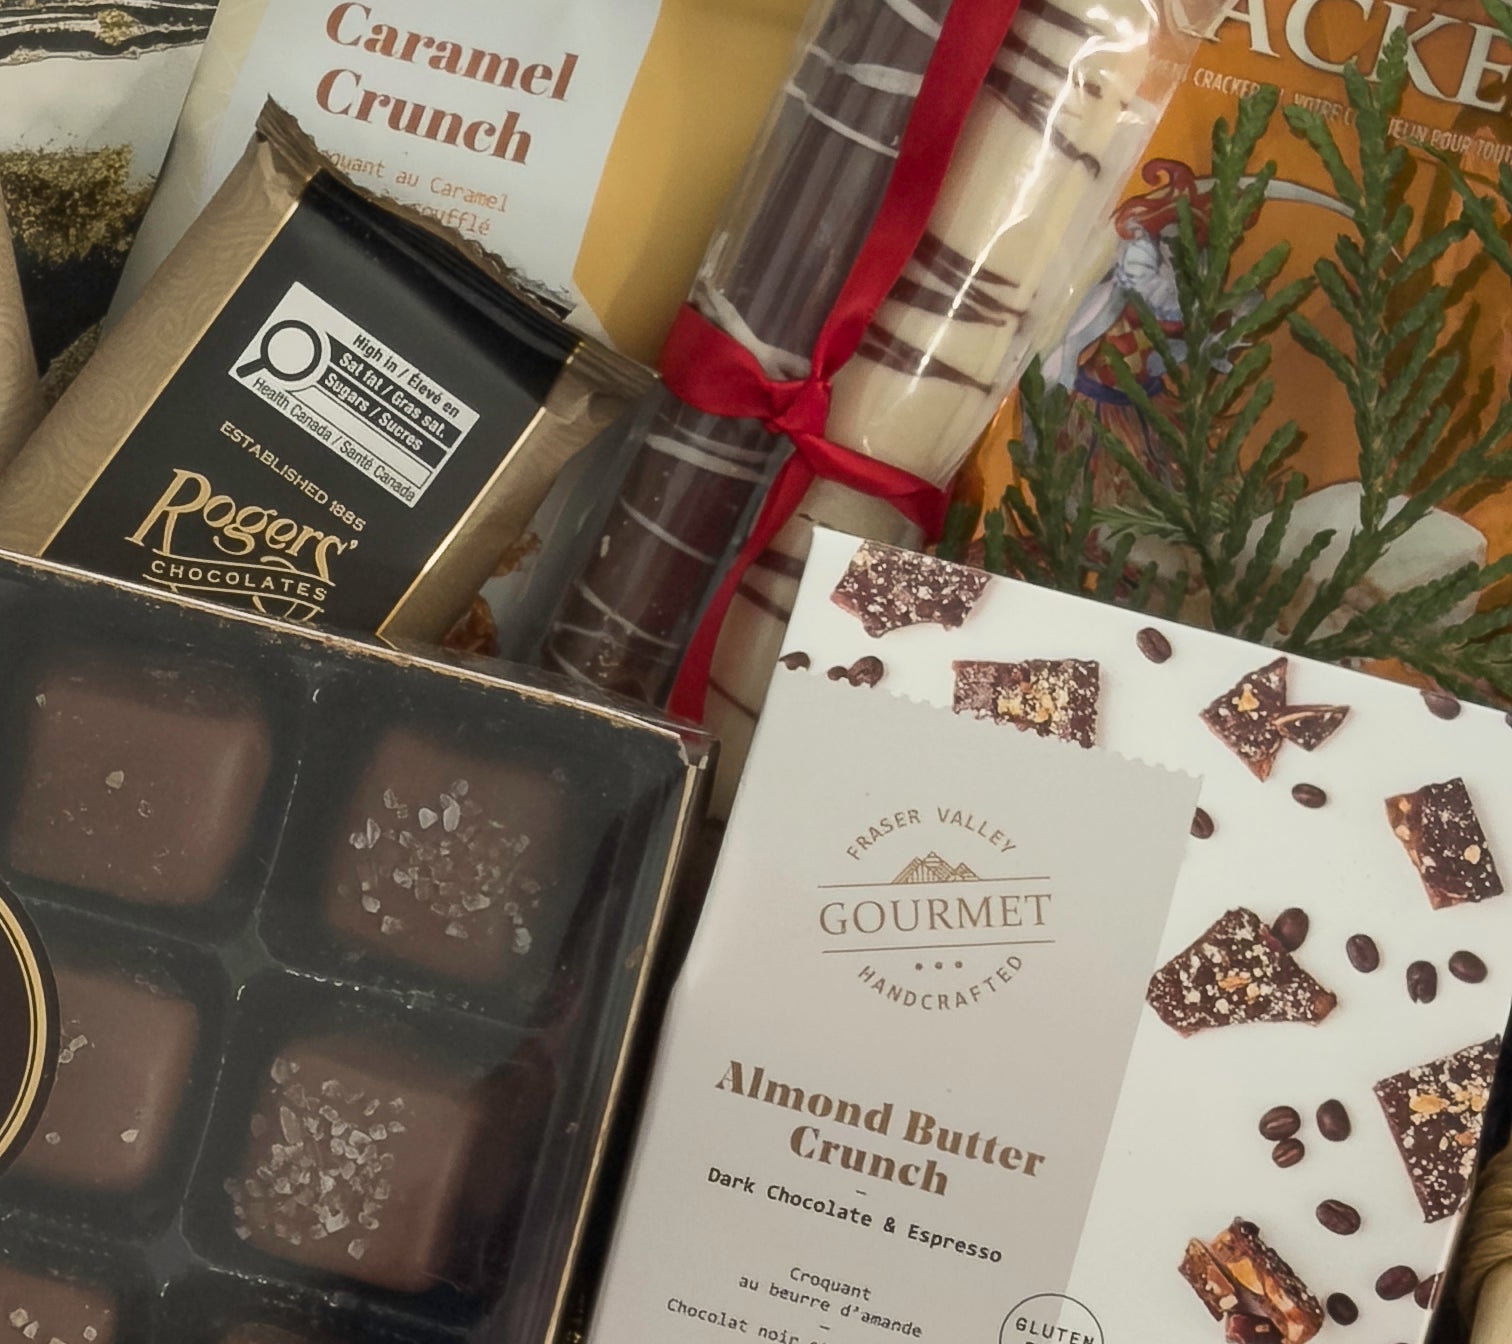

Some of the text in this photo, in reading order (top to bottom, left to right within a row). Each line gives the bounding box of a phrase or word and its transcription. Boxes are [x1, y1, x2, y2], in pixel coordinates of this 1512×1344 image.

[326, 1, 579, 102] Caramel
[316, 68, 532, 165] Crunch
[395, 170, 419, 187] au
[430, 176, 508, 212] Caramel
[324, 373, 370, 412] Sugars
[378, 412, 423, 451] Sucres
[339, 352, 362, 377] Sat
[362, 367, 381, 391] fat
[391, 391, 423, 420] Gras
[421, 414, 445, 438] sat.
[352, 334, 383, 357] High
[383, 355, 398, 374] in
[407, 372, 441, 403] Élevé
[443, 401, 460, 418] en
[219, 420, 367, 532] ESTABLISHED 1885
[252, 377, 290, 411] Health
[290, 403, 332, 443] Canada
[339, 440, 376, 471] Santé
[373, 464, 416, 502] Canada
[151, 560, 327, 601] CHOCOLATES
[846, 807, 1017, 860] FRASER VALLEY
[819, 894, 1052, 936] GOURMET
[858, 955, 1023, 1011] HANDCRAFTED
[715, 1060, 1047, 1177] Almond Butter
[790, 1125, 949, 1196] Crunch
[707, 1167, 1002, 1263] Dark Chocolate & Espresso
[667, 1297, 748, 1333] Chocolat
[738, 1275, 923, 1339] au beurre d'amande
[790, 1267, 872, 1302] Croquant
